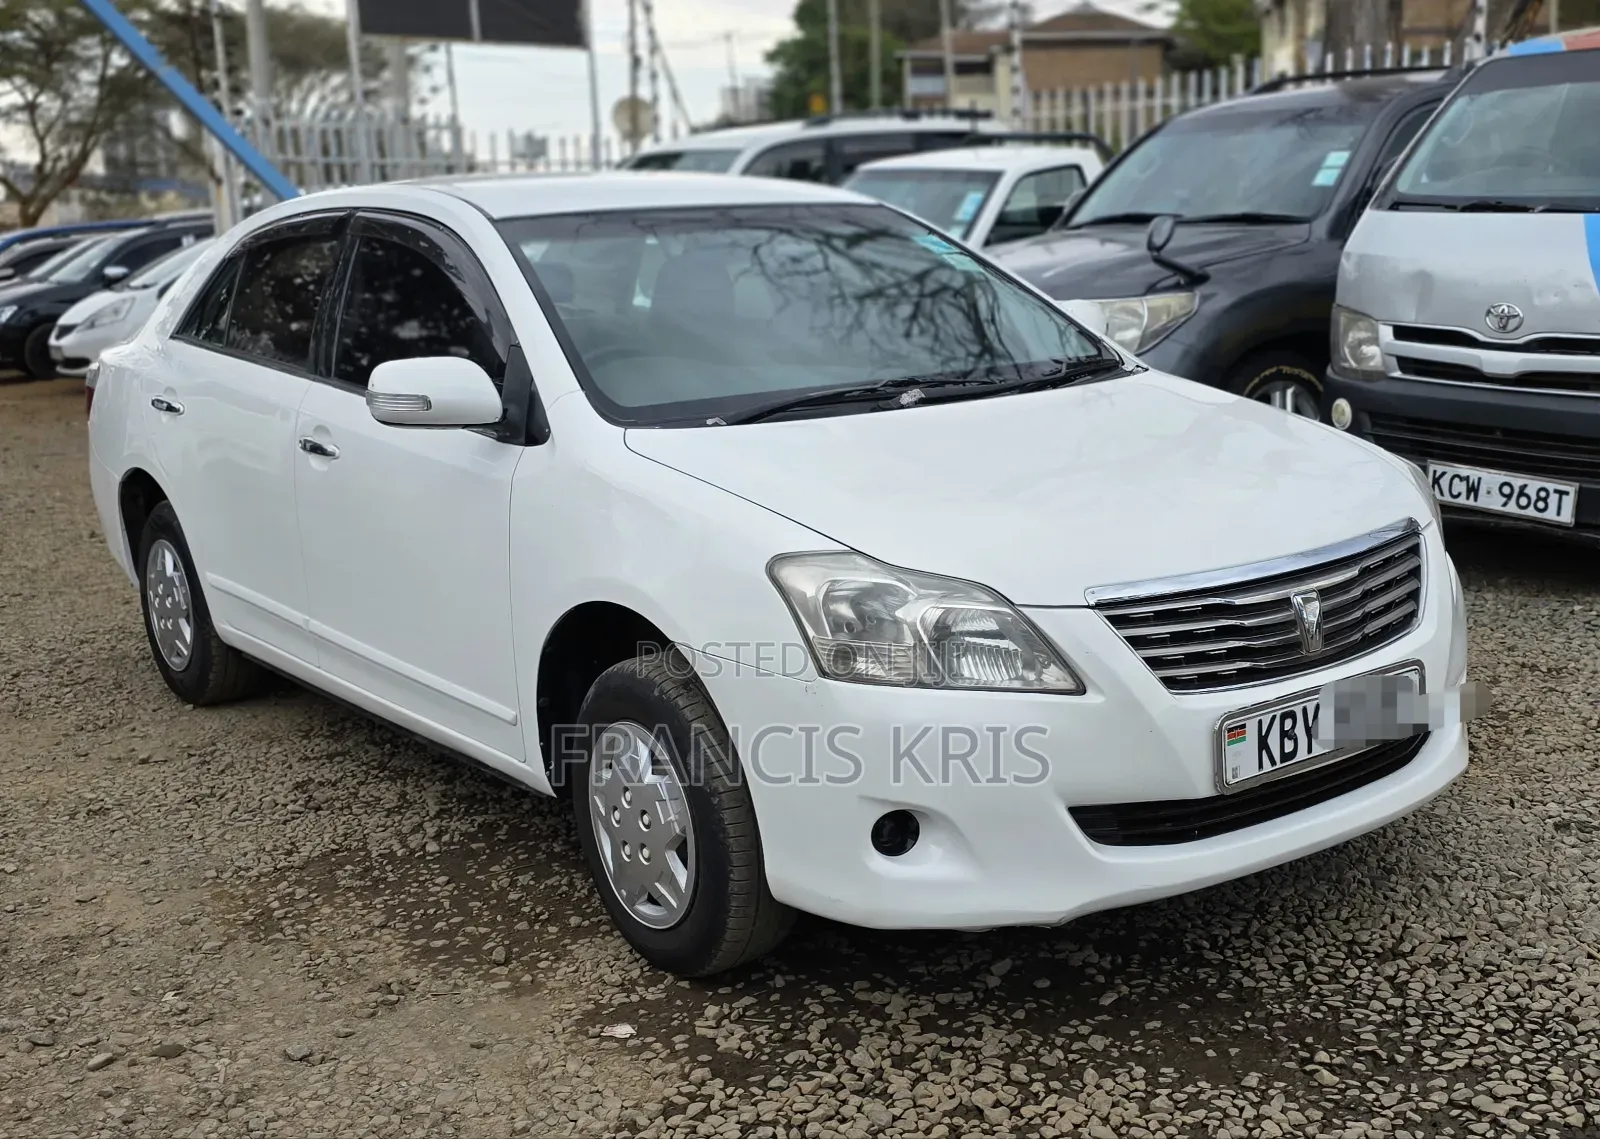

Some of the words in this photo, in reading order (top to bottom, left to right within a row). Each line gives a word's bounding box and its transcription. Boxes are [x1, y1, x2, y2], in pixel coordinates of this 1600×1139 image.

[1431, 469, 1482, 503] KCW
[1498, 481, 1570, 517] 968T
[1257, 702, 1320, 771] KBY
